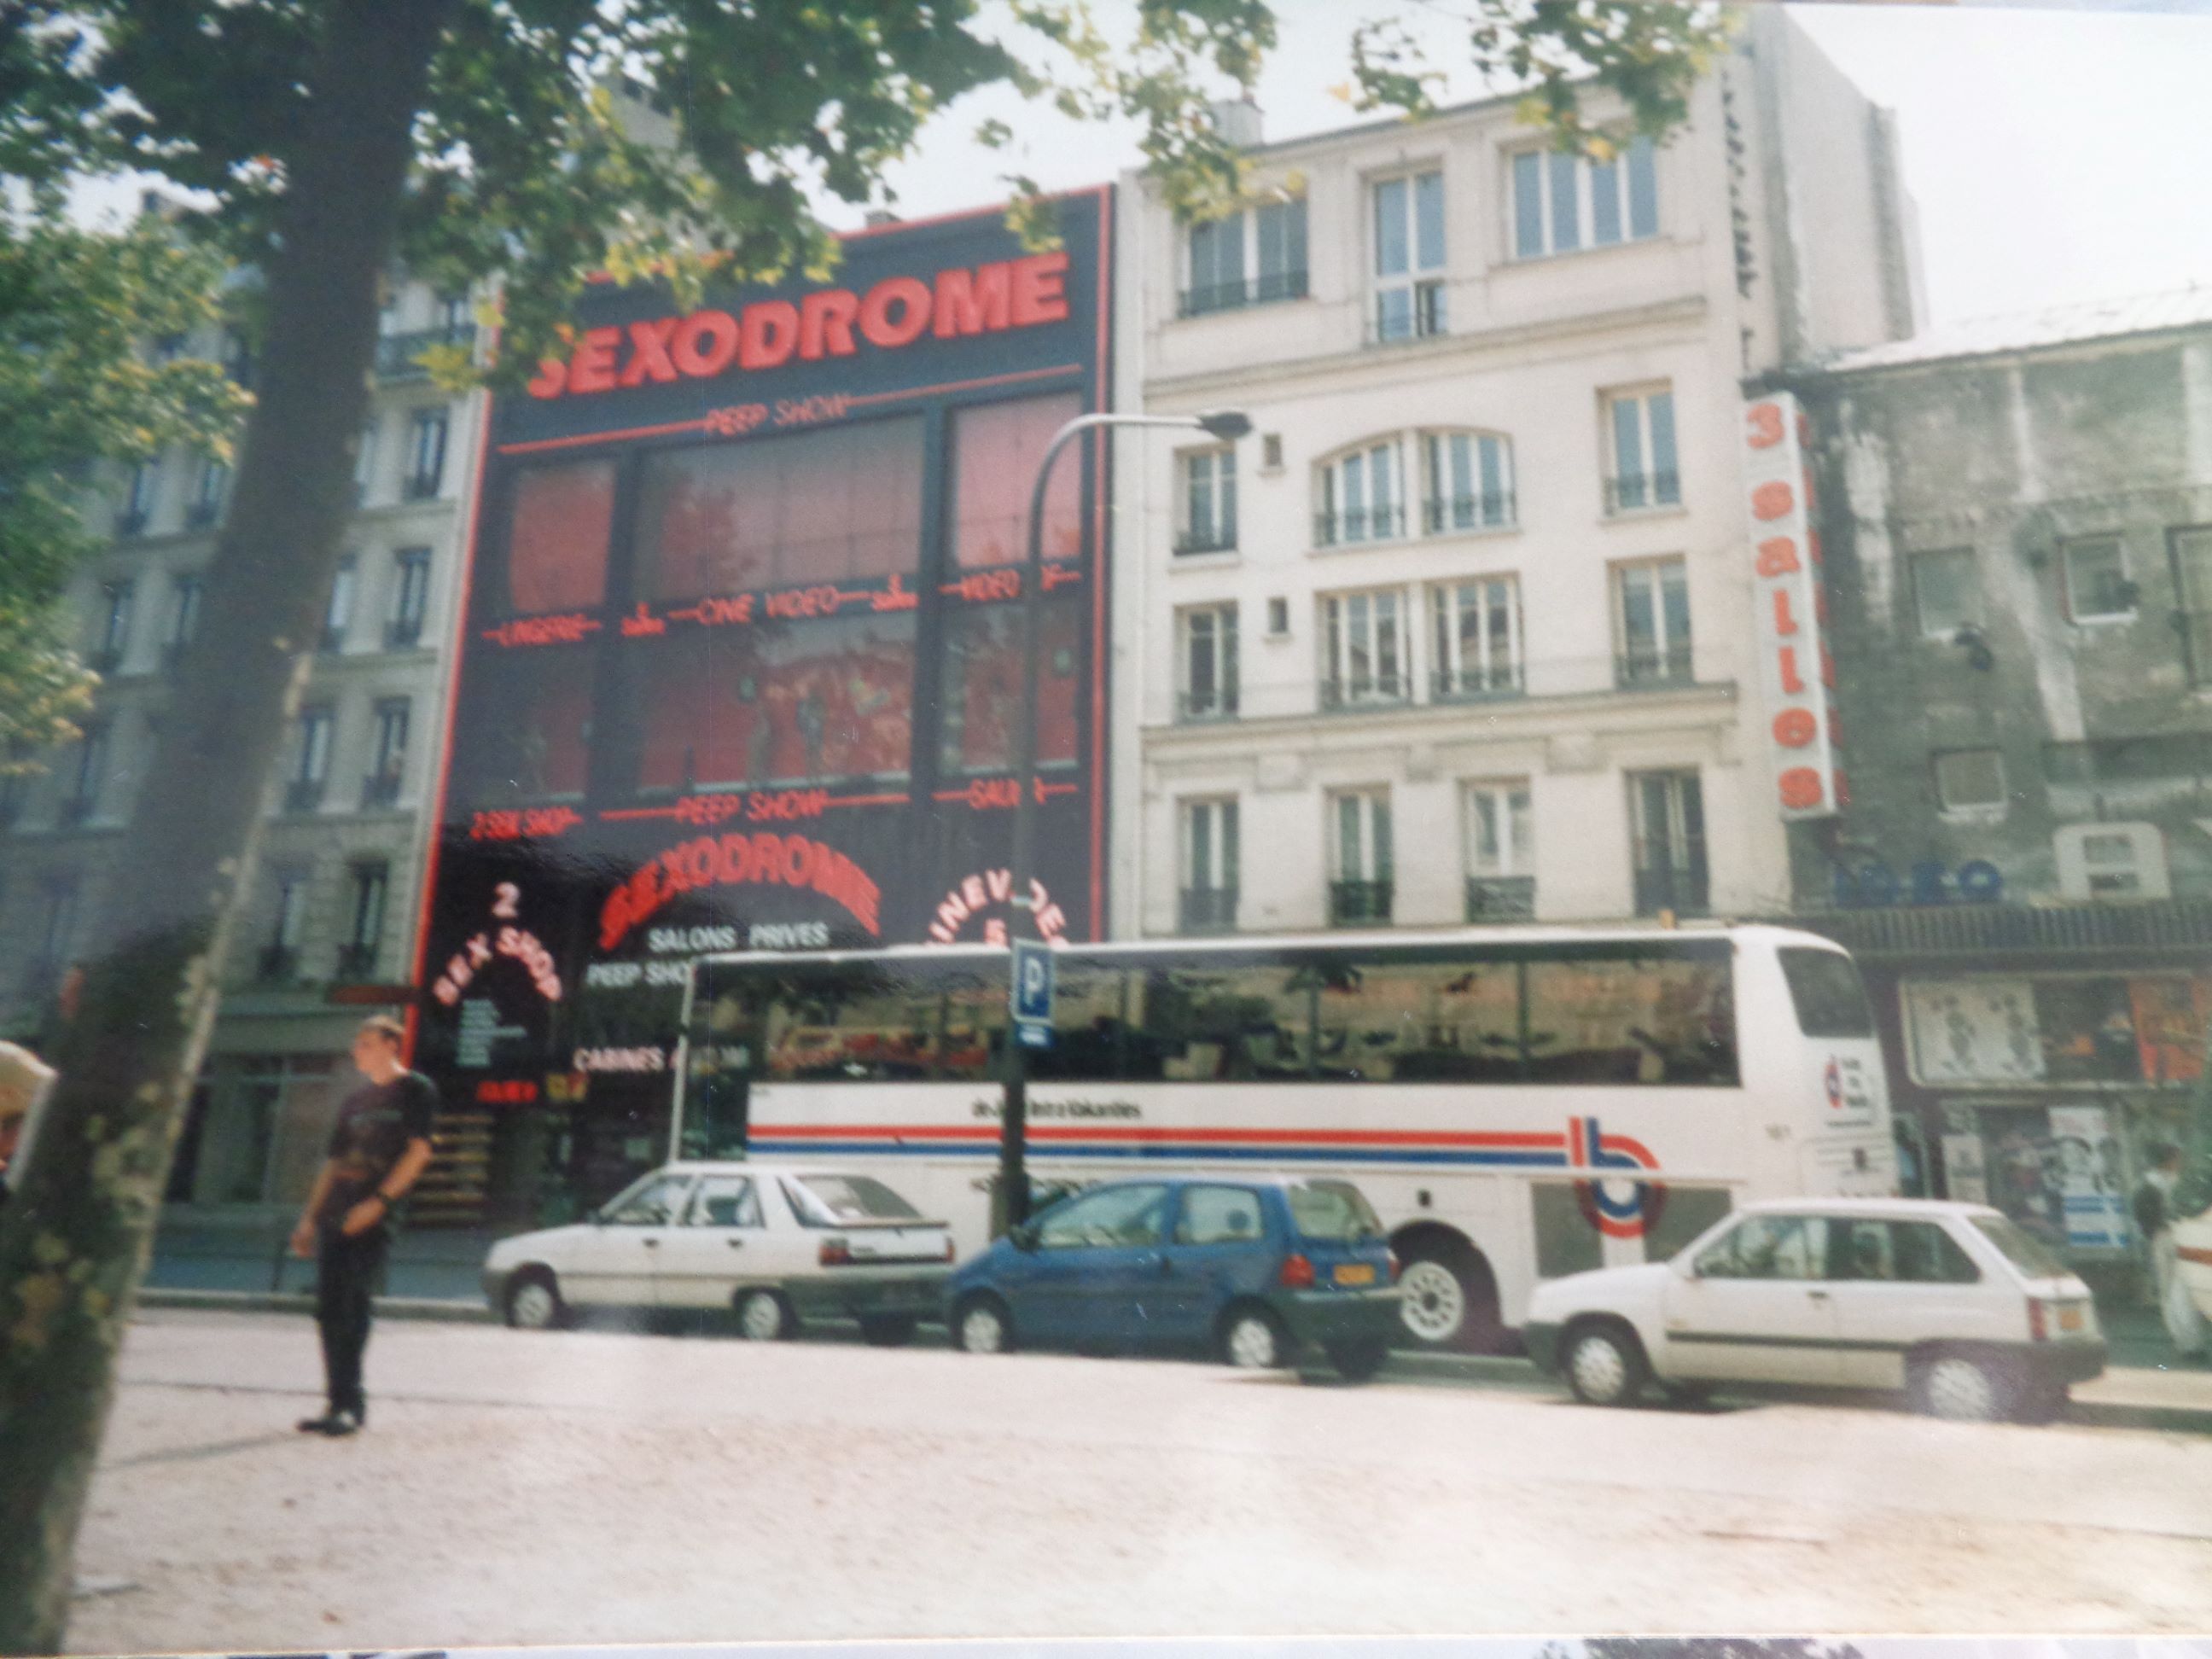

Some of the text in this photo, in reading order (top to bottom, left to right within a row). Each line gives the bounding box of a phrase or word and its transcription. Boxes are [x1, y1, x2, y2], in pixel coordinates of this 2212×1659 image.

[674, 788, 830, 825] PEEP SHOW
[492, 881, 521, 918] 2
[599, 832, 882, 952] SEXODROME
[649, 920, 830, 953] SALONS PRIVES
[585, 961, 641, 988] PEEP
[1024, 957, 1043, 1007] P
